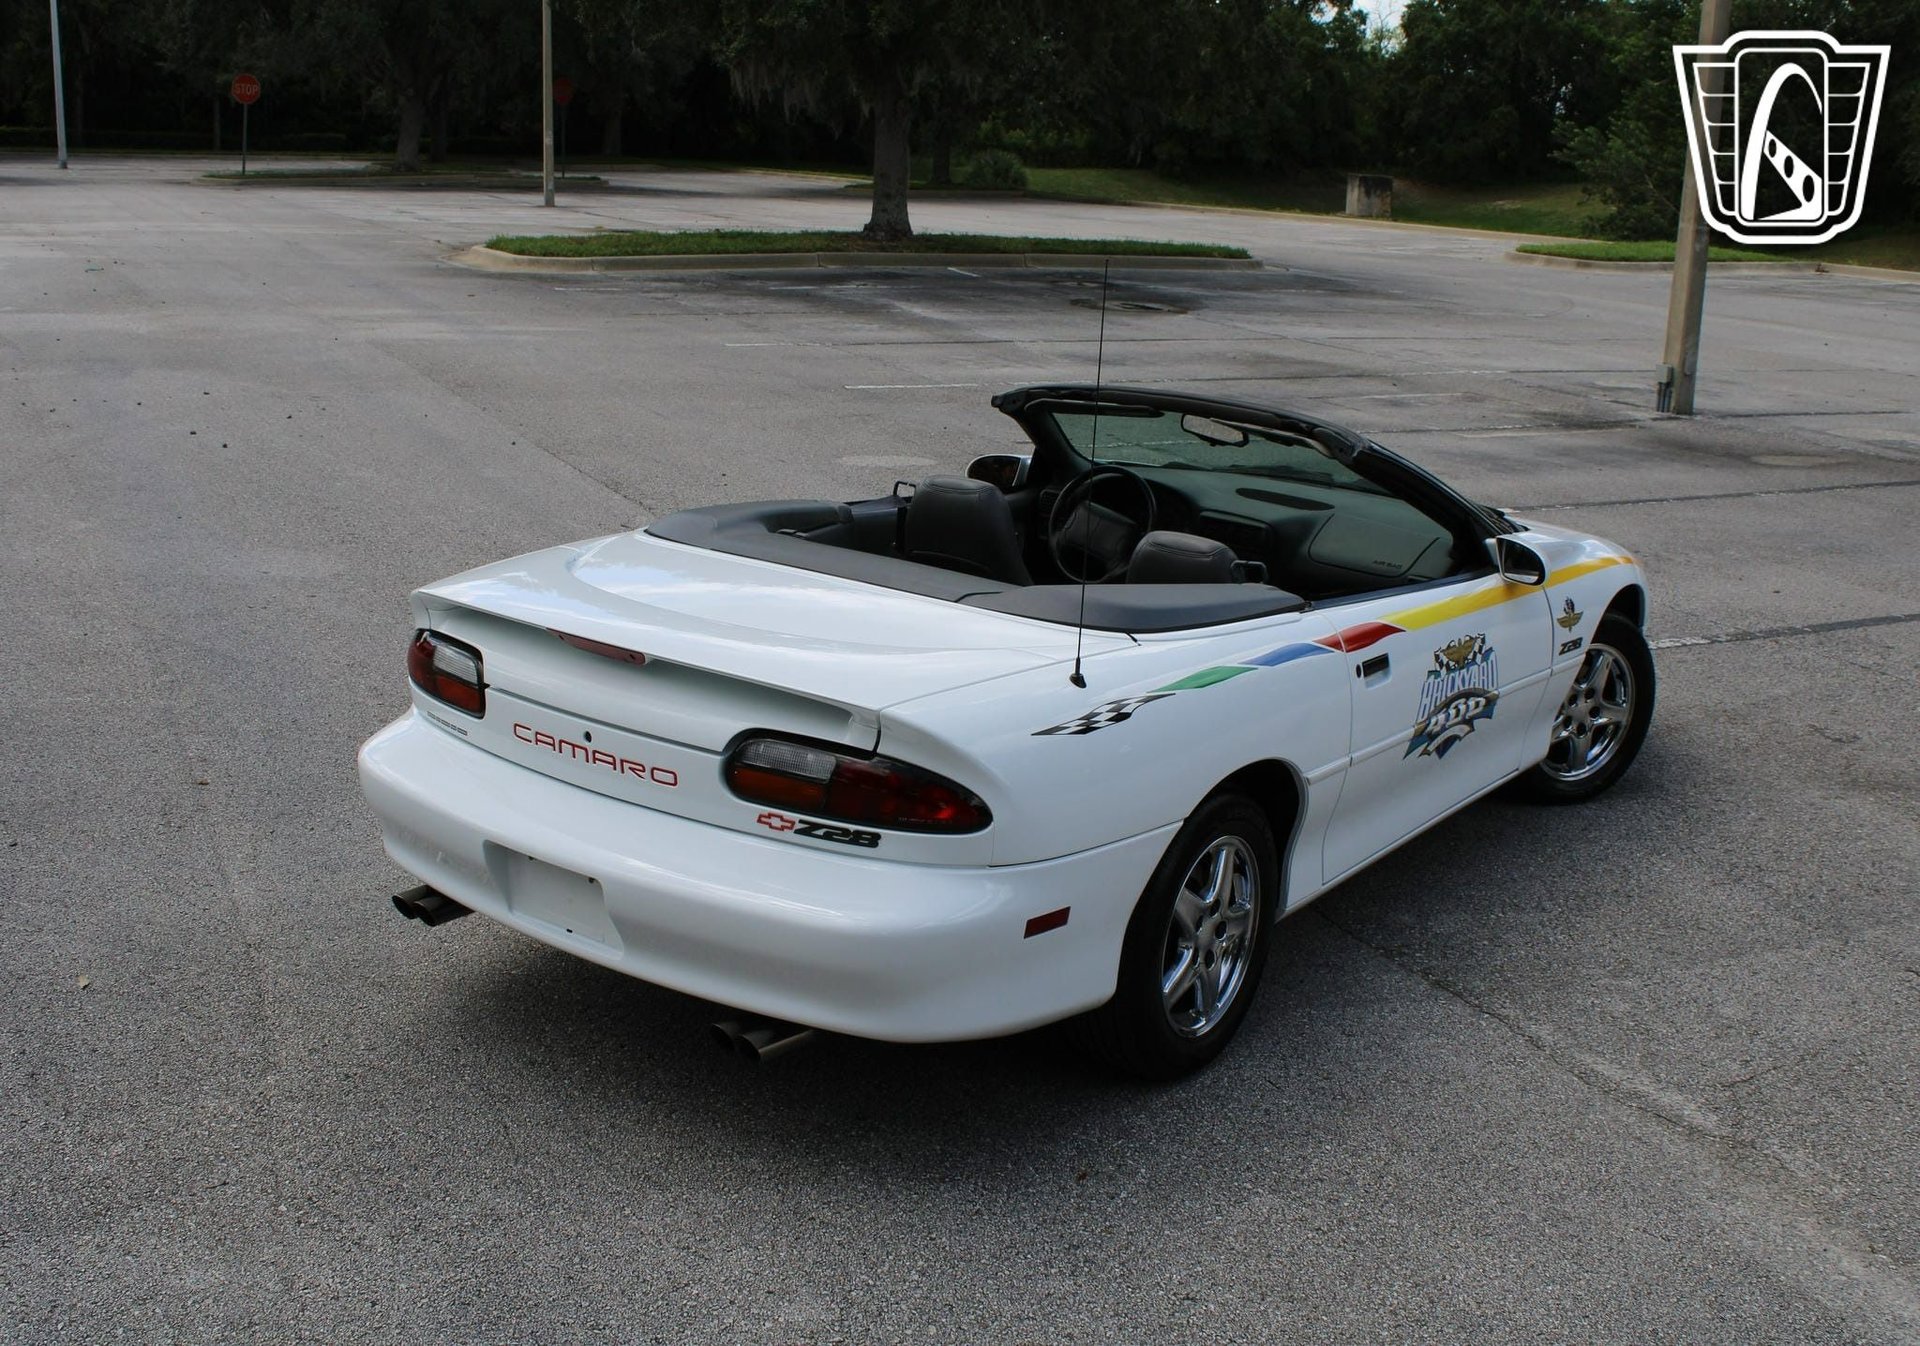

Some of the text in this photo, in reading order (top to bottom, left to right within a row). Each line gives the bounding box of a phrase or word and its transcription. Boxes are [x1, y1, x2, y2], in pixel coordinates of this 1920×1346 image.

[235, 83, 258, 95] STOP
[1416, 651, 1499, 724] BRICKYARD
[513, 722, 679, 787] CAMARO
[793, 819, 881, 848] Z28
